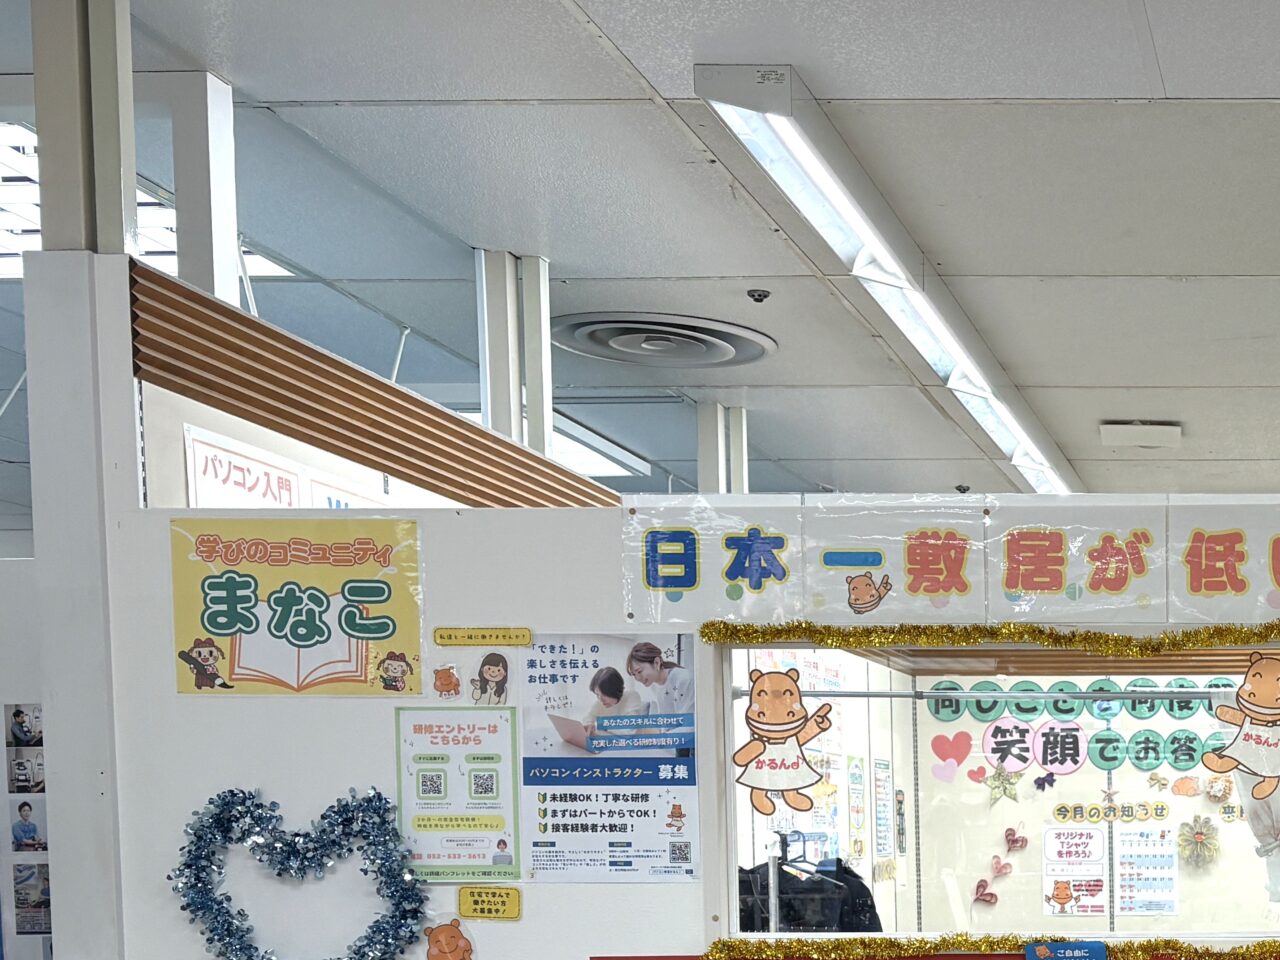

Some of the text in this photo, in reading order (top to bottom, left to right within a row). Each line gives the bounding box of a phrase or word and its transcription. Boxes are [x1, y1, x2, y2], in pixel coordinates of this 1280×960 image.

[202, 455, 293, 507] パソコン入門
[196, 535, 392, 567] 学びのコミュニティ
[201, 570, 397, 647] まなこ
[527, 659, 599, 669] 楽しさを伝える
[528, 674, 579, 684] お仕事です
[603, 717, 683, 726] あなたのスキルに合わせて
[413, 724, 497, 733] 研修エントリーは
[430, 736, 482, 745] こちらから
[529, 765, 689, 779] パソコンインストラクター 募集
[1057, 804, 1166, 818] 今月のお知らせ
[1057, 949, 1089, 957] ご自由に
